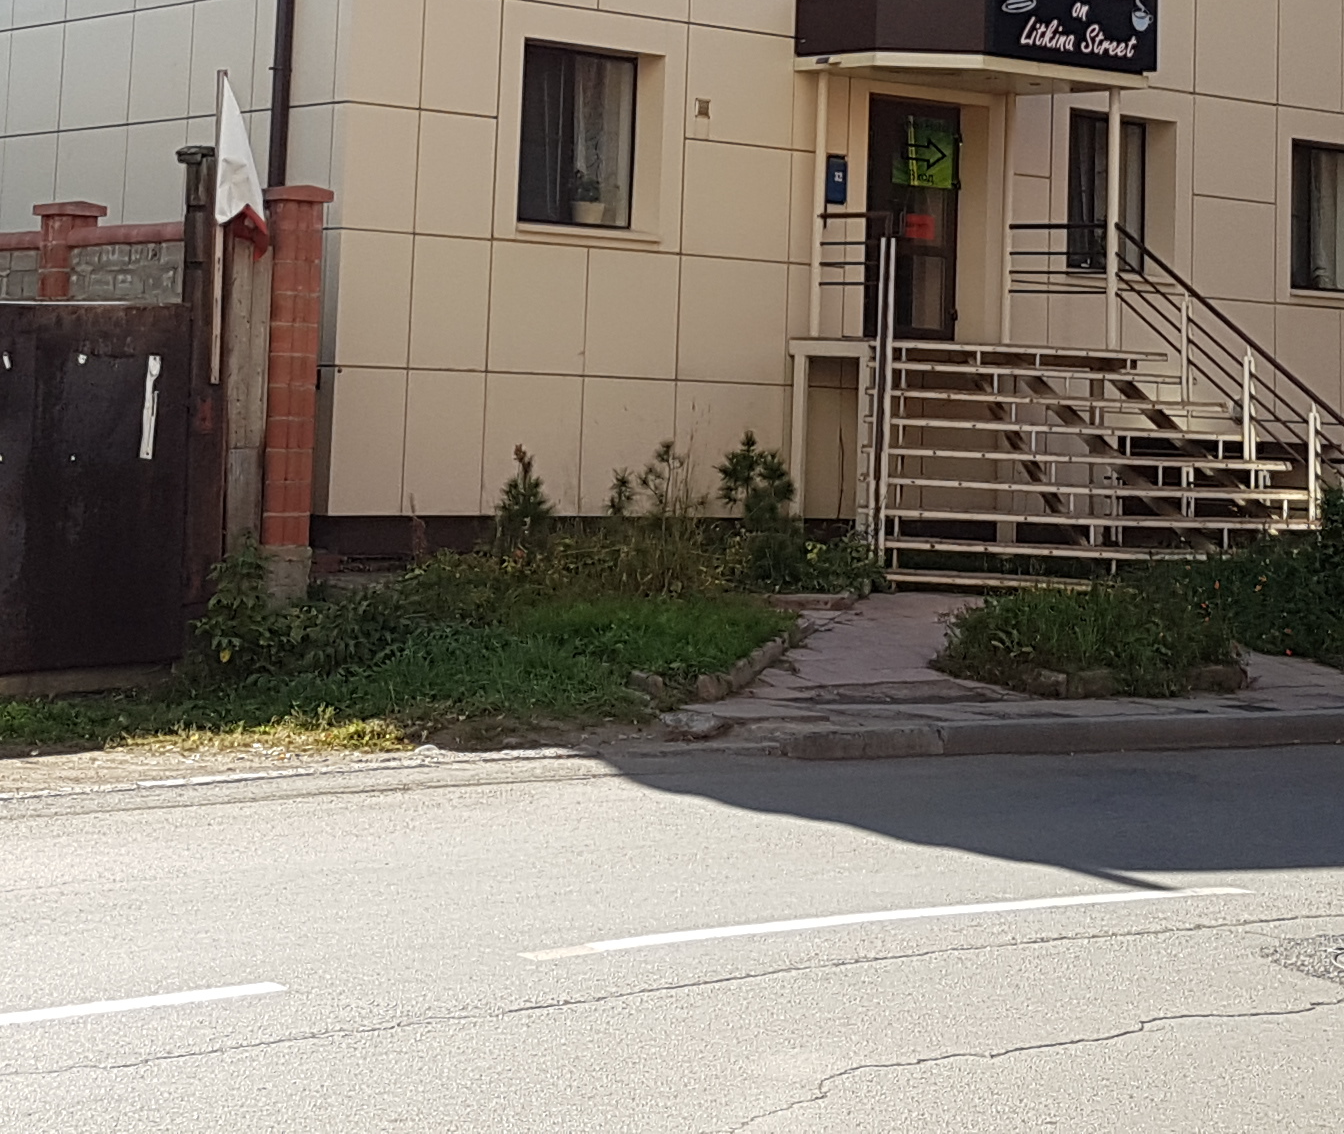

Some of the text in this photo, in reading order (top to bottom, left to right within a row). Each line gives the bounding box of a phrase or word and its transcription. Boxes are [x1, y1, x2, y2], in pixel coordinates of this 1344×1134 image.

[1071, 1, 1089, 21] on
[1019, 16, 1137, 58] Litkina Street
